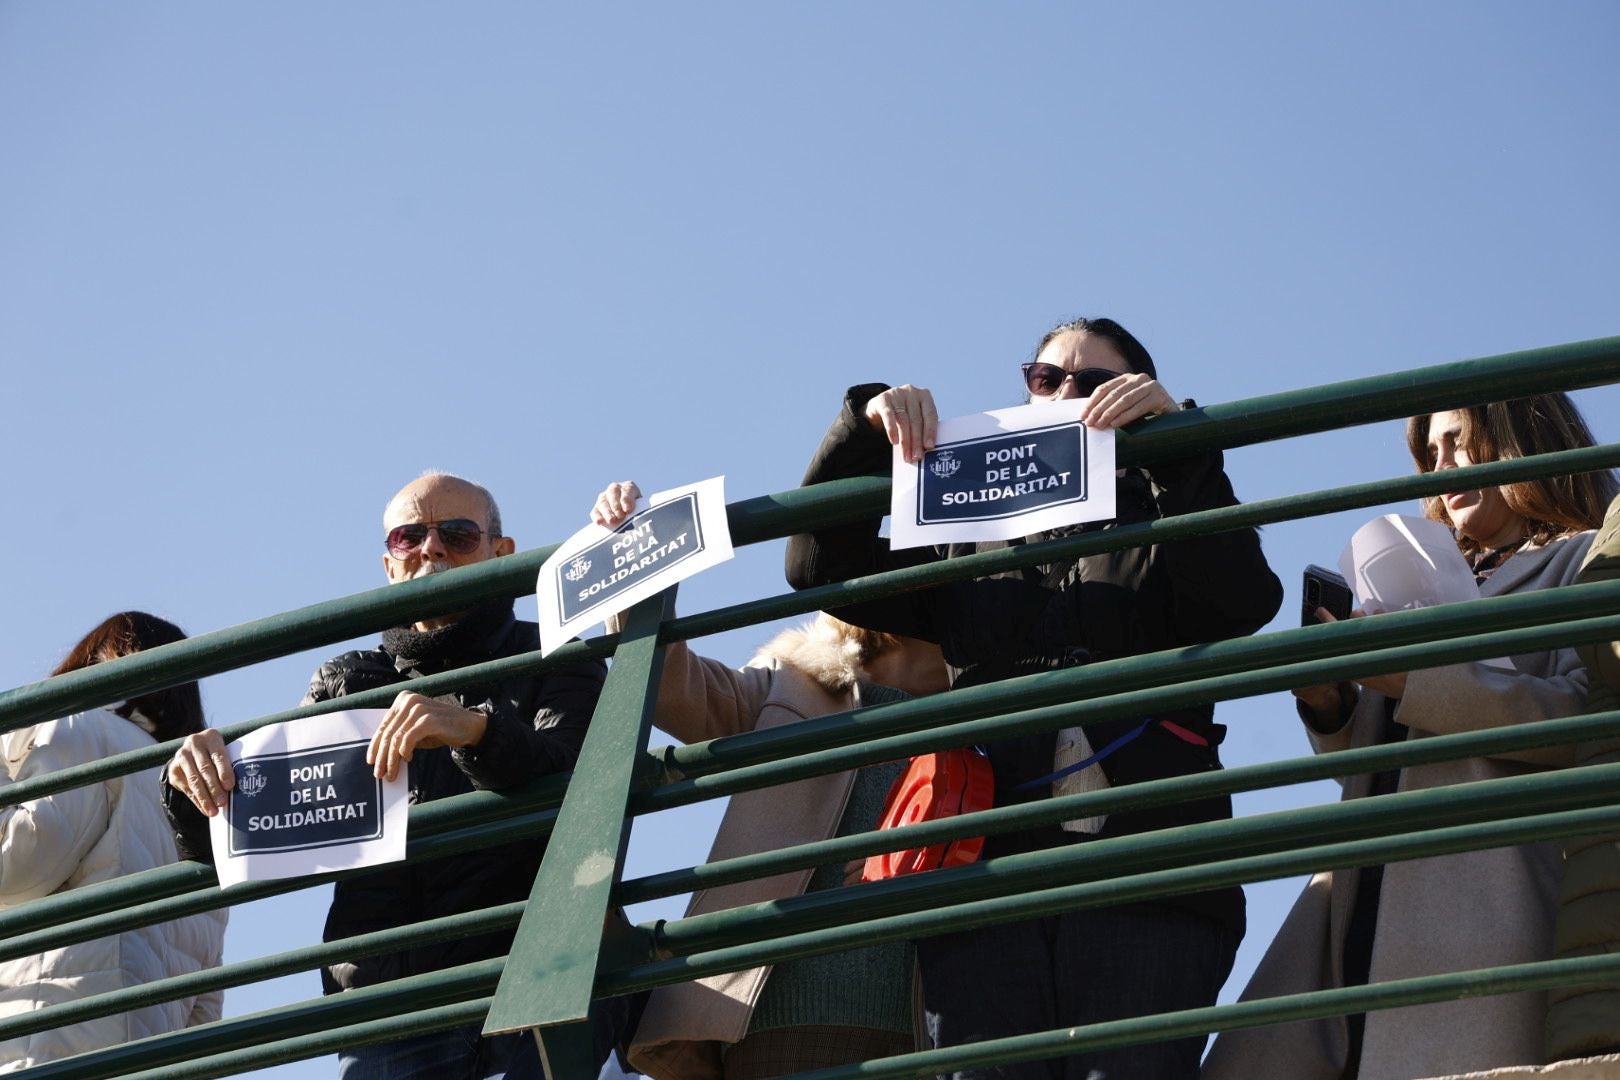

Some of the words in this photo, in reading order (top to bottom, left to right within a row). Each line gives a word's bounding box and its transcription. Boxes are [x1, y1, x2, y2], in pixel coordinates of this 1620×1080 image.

[985, 443, 1037, 465] PONT
[986, 467, 1010, 483] DE
[1016, 462, 1038, 478] LA
[942, 471, 1071, 506] SOLIDARITAT
[612, 519, 653, 555] PONT
[614, 549, 636, 569] DE
[639, 535, 659, 554] LA
[578, 532, 688, 602] SOLIDARITAT
[290, 762, 335, 783] PONT
[290, 788, 311, 805] DE
[316, 785, 337, 801] LA
[248, 802, 367, 832] SOLIDARITAT
